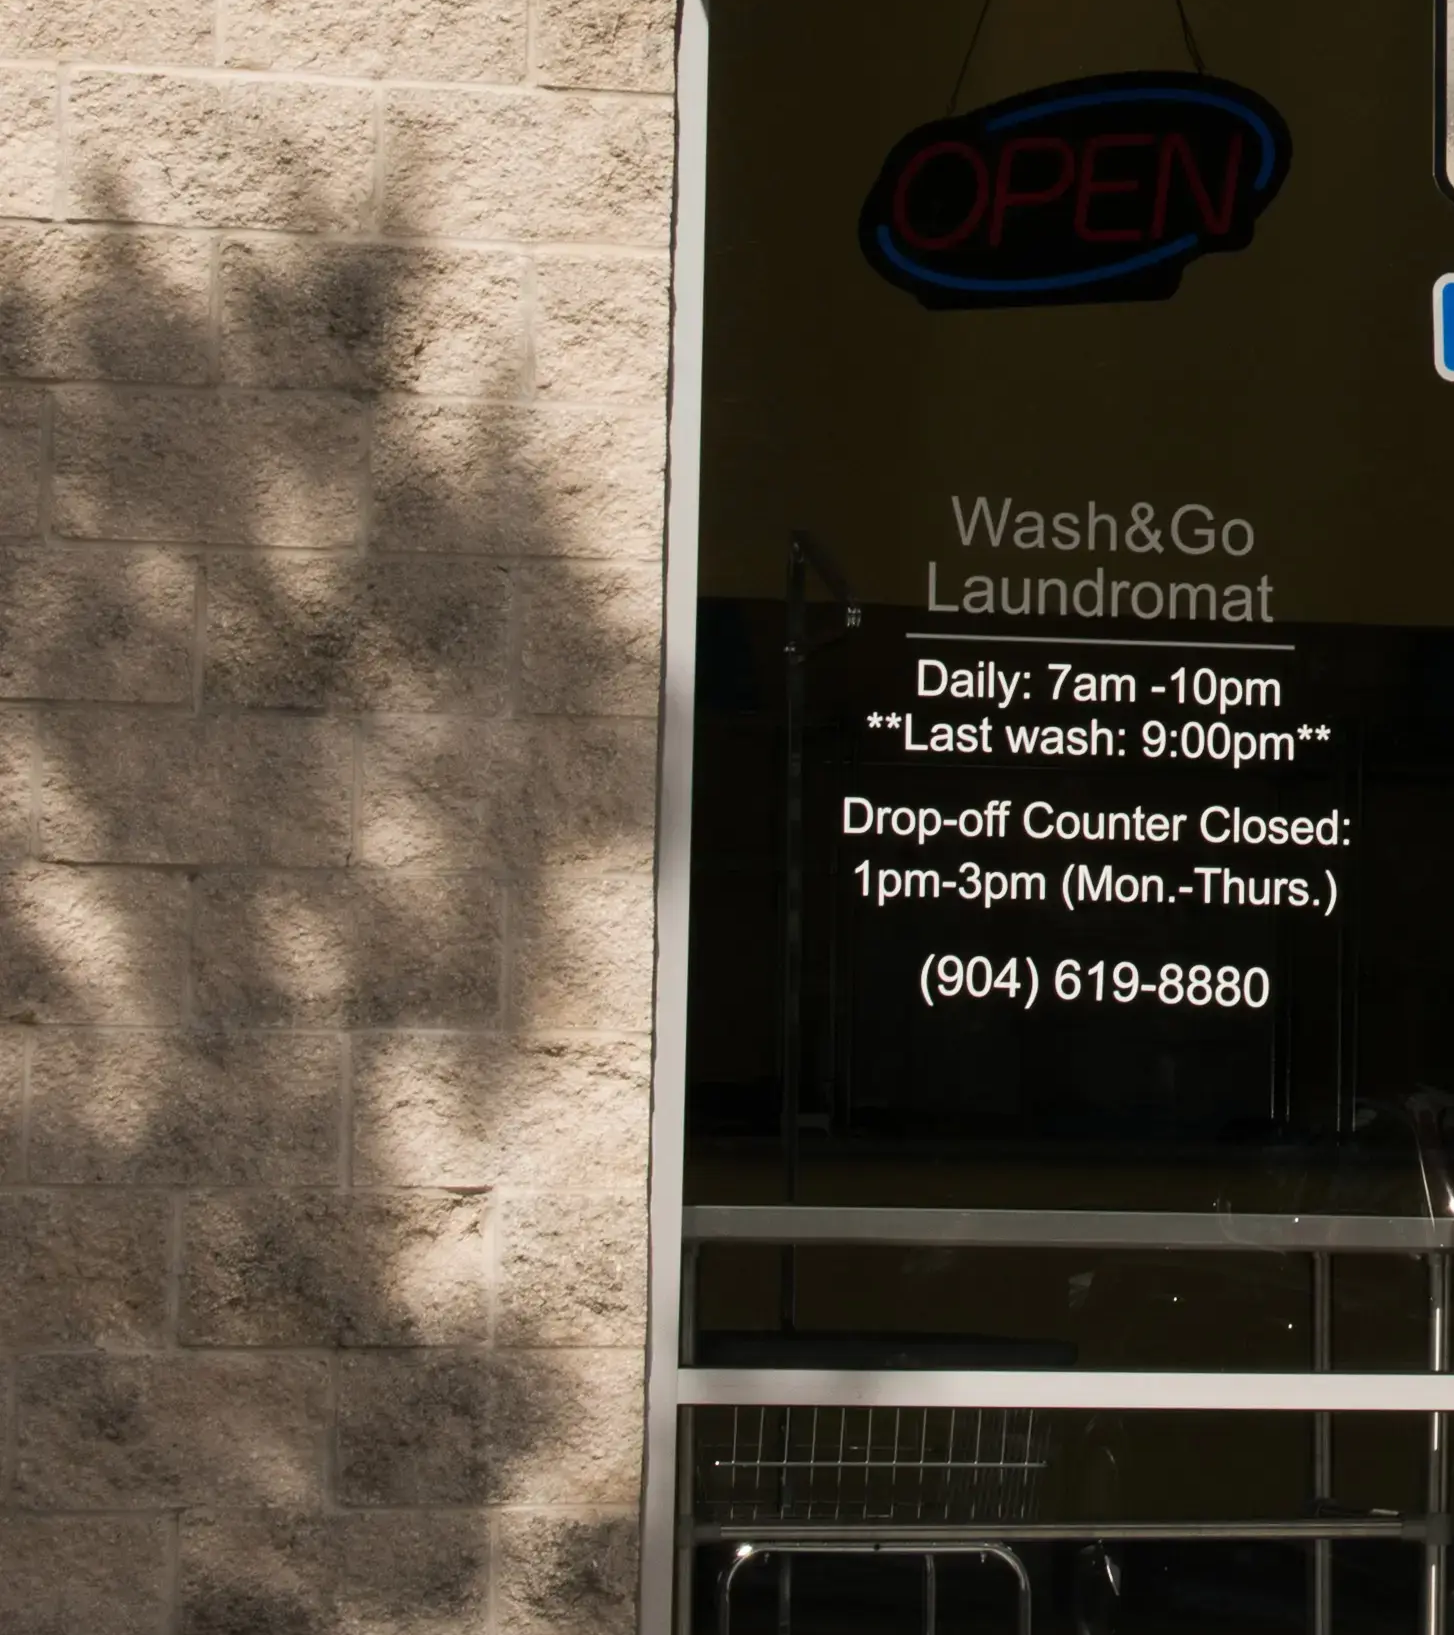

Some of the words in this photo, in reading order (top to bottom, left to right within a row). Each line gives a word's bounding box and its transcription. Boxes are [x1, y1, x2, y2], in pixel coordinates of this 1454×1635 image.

[892, 131, 1245, 251] OPEN
[951, 495, 1254, 556] Wash&Go
[928, 561, 1274, 623] Laundromat
[917, 659, 1031, 709] Daily:
[1047, 663, 1136, 703] 7am
[1151, 666, 1281, 715] -10pm
[1005, 718, 1126, 757] wash:
[843, 796, 1012, 845] Drop-off
[1023, 801, 1188, 842] Counter
[1200, 805, 1350, 846] Closed:
[854, 859, 1046, 909] 1pm-3pm
[1062, 863, 1337, 917] (Mon.-Thurs.)
[920, 953, 1039, 1010] (904)
[1054, 958, 1270, 1008] 619-8880
